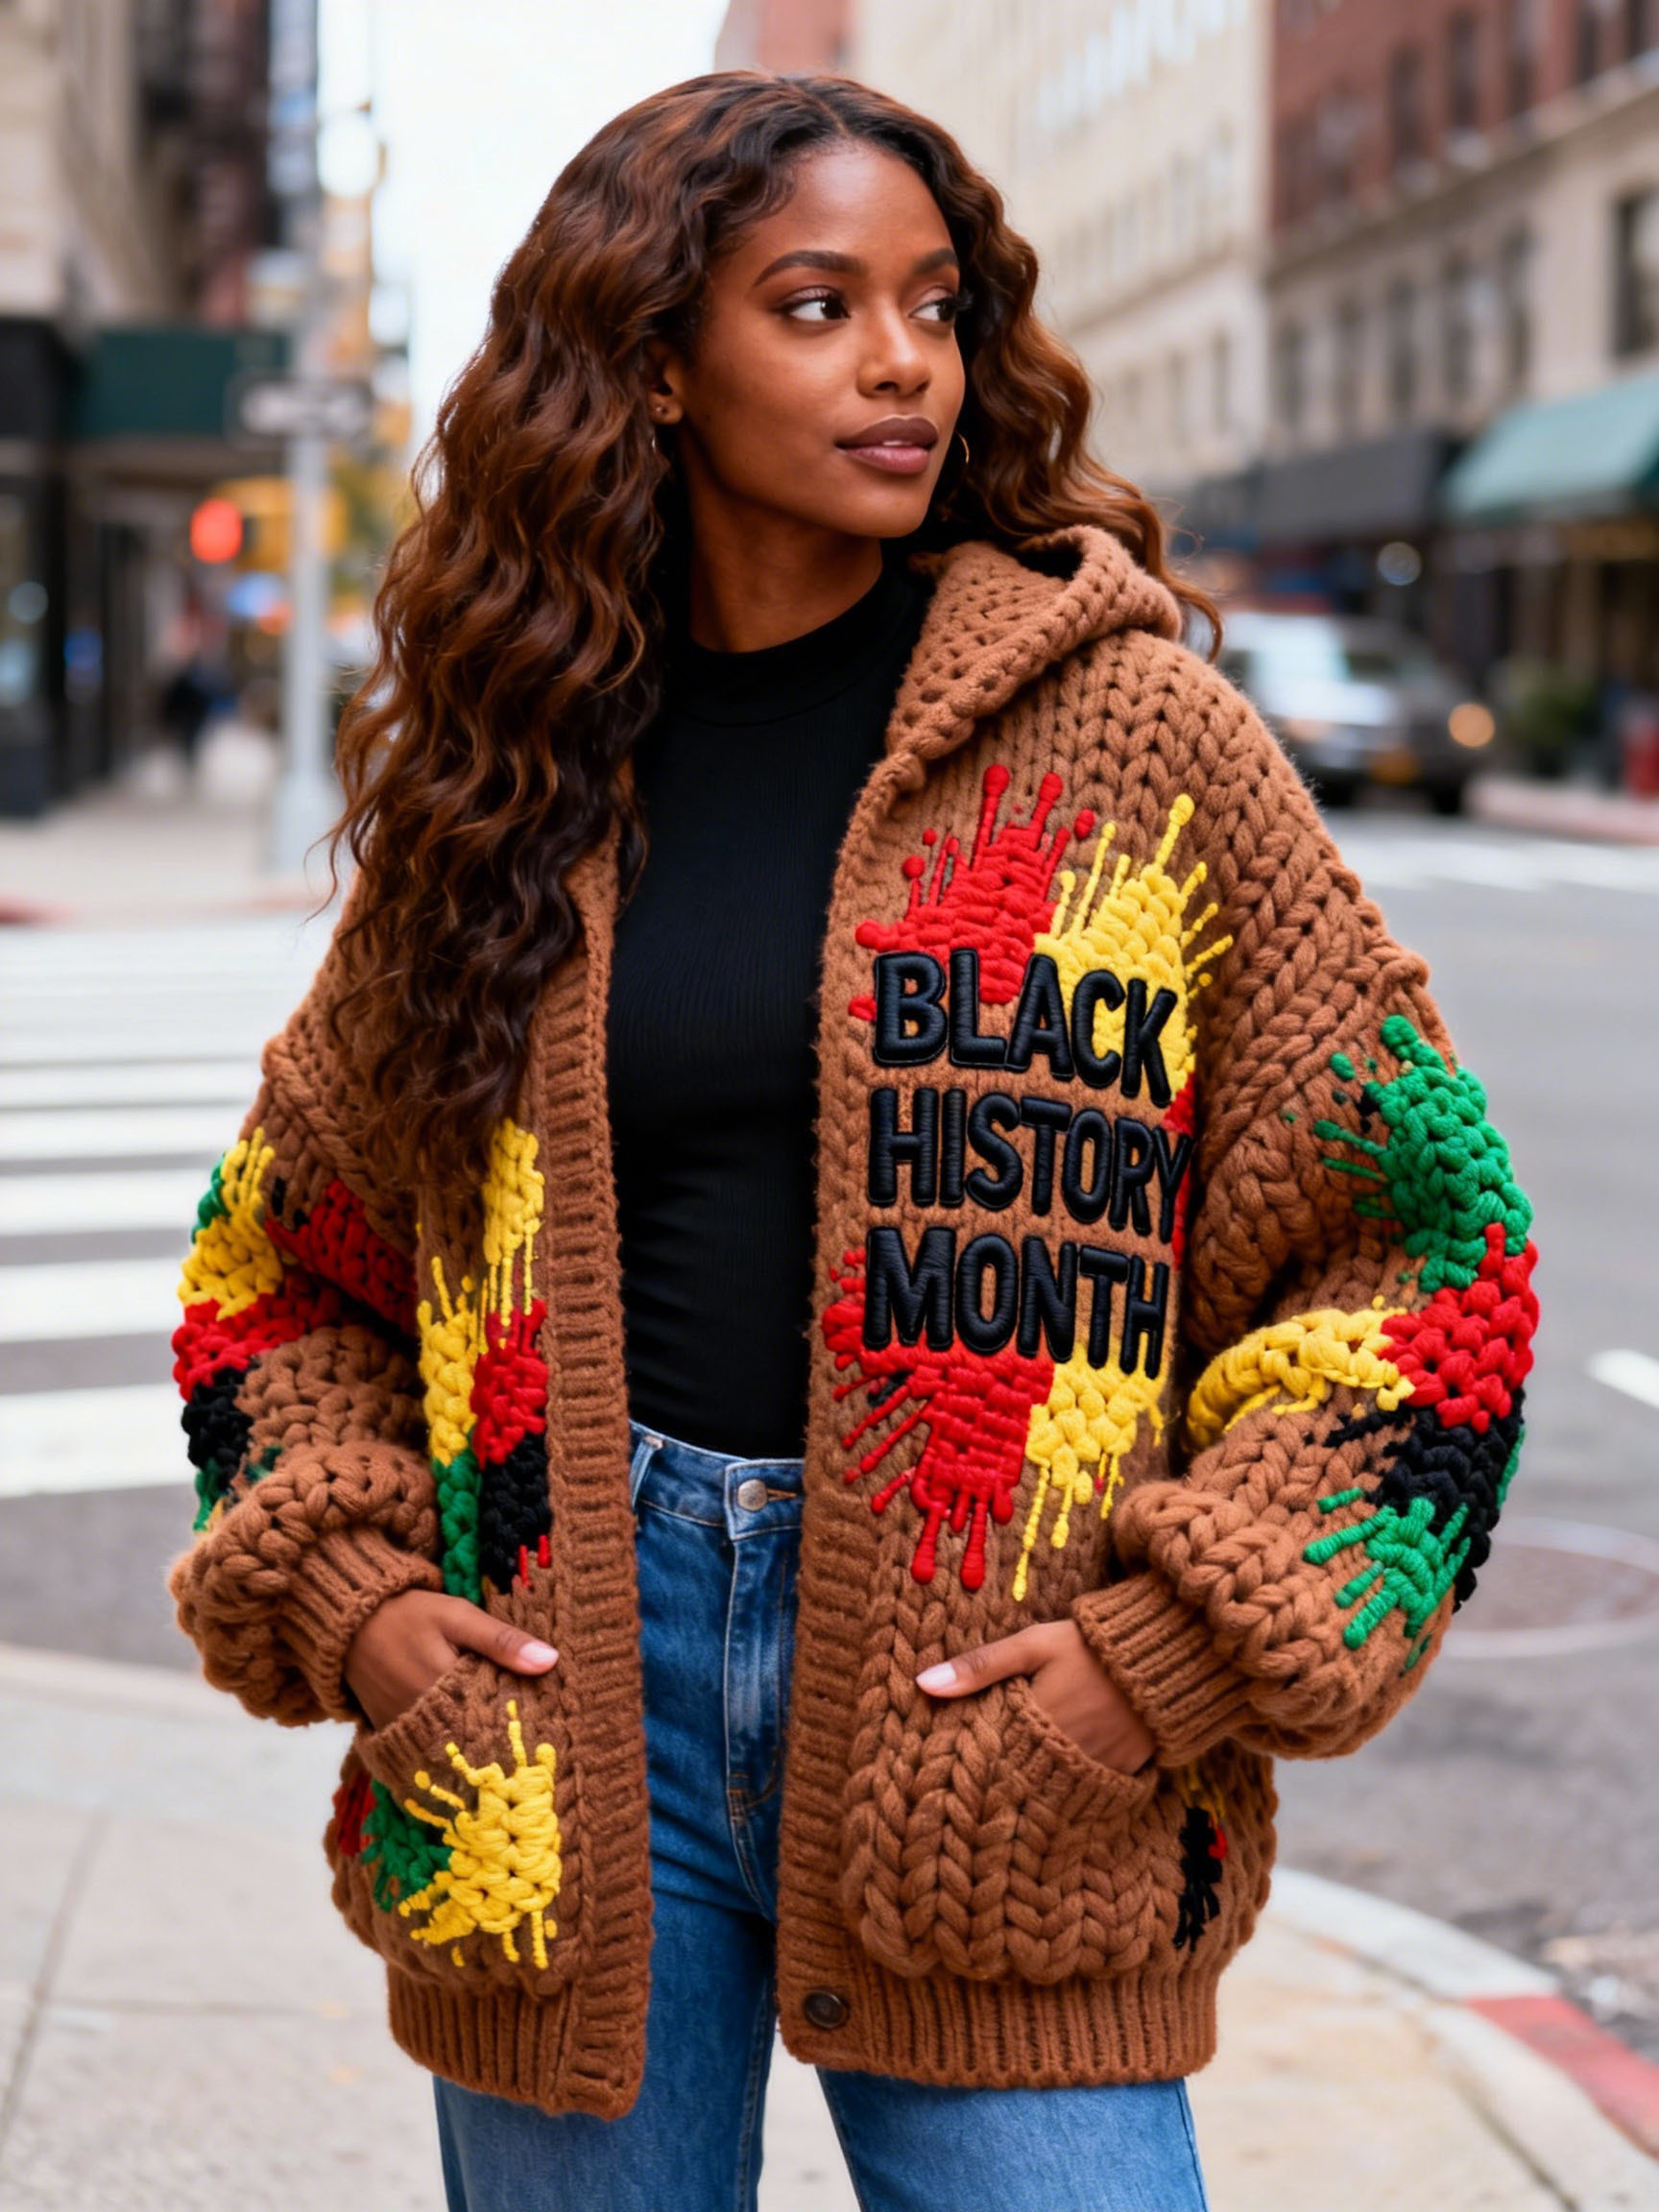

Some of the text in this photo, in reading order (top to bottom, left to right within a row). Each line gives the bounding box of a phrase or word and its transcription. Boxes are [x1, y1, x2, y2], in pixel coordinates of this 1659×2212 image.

[874, 949, 1177, 1108] BLACK
[868, 1088, 1193, 1244] HISTORY
[864, 1226, 1169, 1380] MONTH
